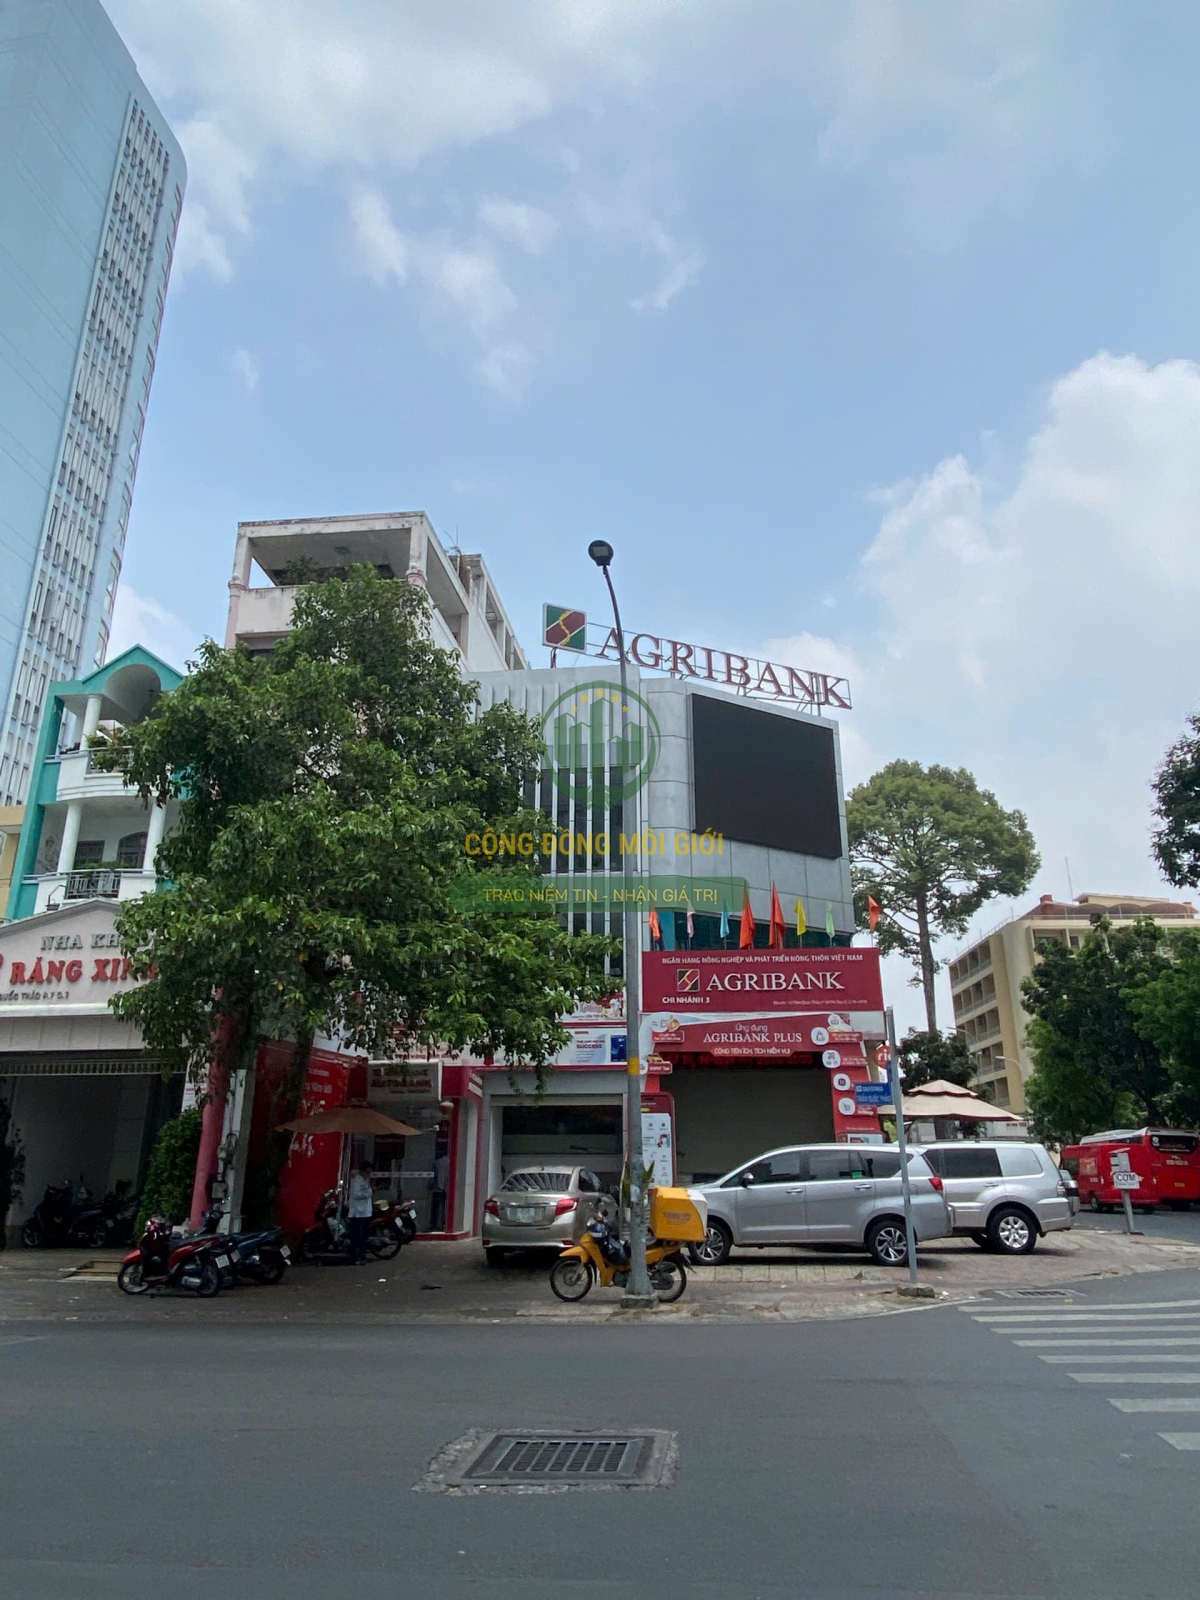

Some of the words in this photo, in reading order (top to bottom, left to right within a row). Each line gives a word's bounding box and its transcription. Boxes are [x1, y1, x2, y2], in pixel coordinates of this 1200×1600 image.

[595, 627, 853, 710] AGRIBANK
[40, 935, 83, 950] NHA
[662, 956, 681, 964] NGÂN
[811, 954, 829, 962] THÔN
[831, 954, 845, 962] VIỆT
[10, 956, 83, 984] RĂNG
[706, 971, 846, 992] AGRIBANK
[676, 996, 704, 1004] NHÁNH
[751, 1024, 768, 1033] dụng
[703, 1033, 770, 1043] AGRIBANK
[774, 1033, 802, 1042] PLUS
